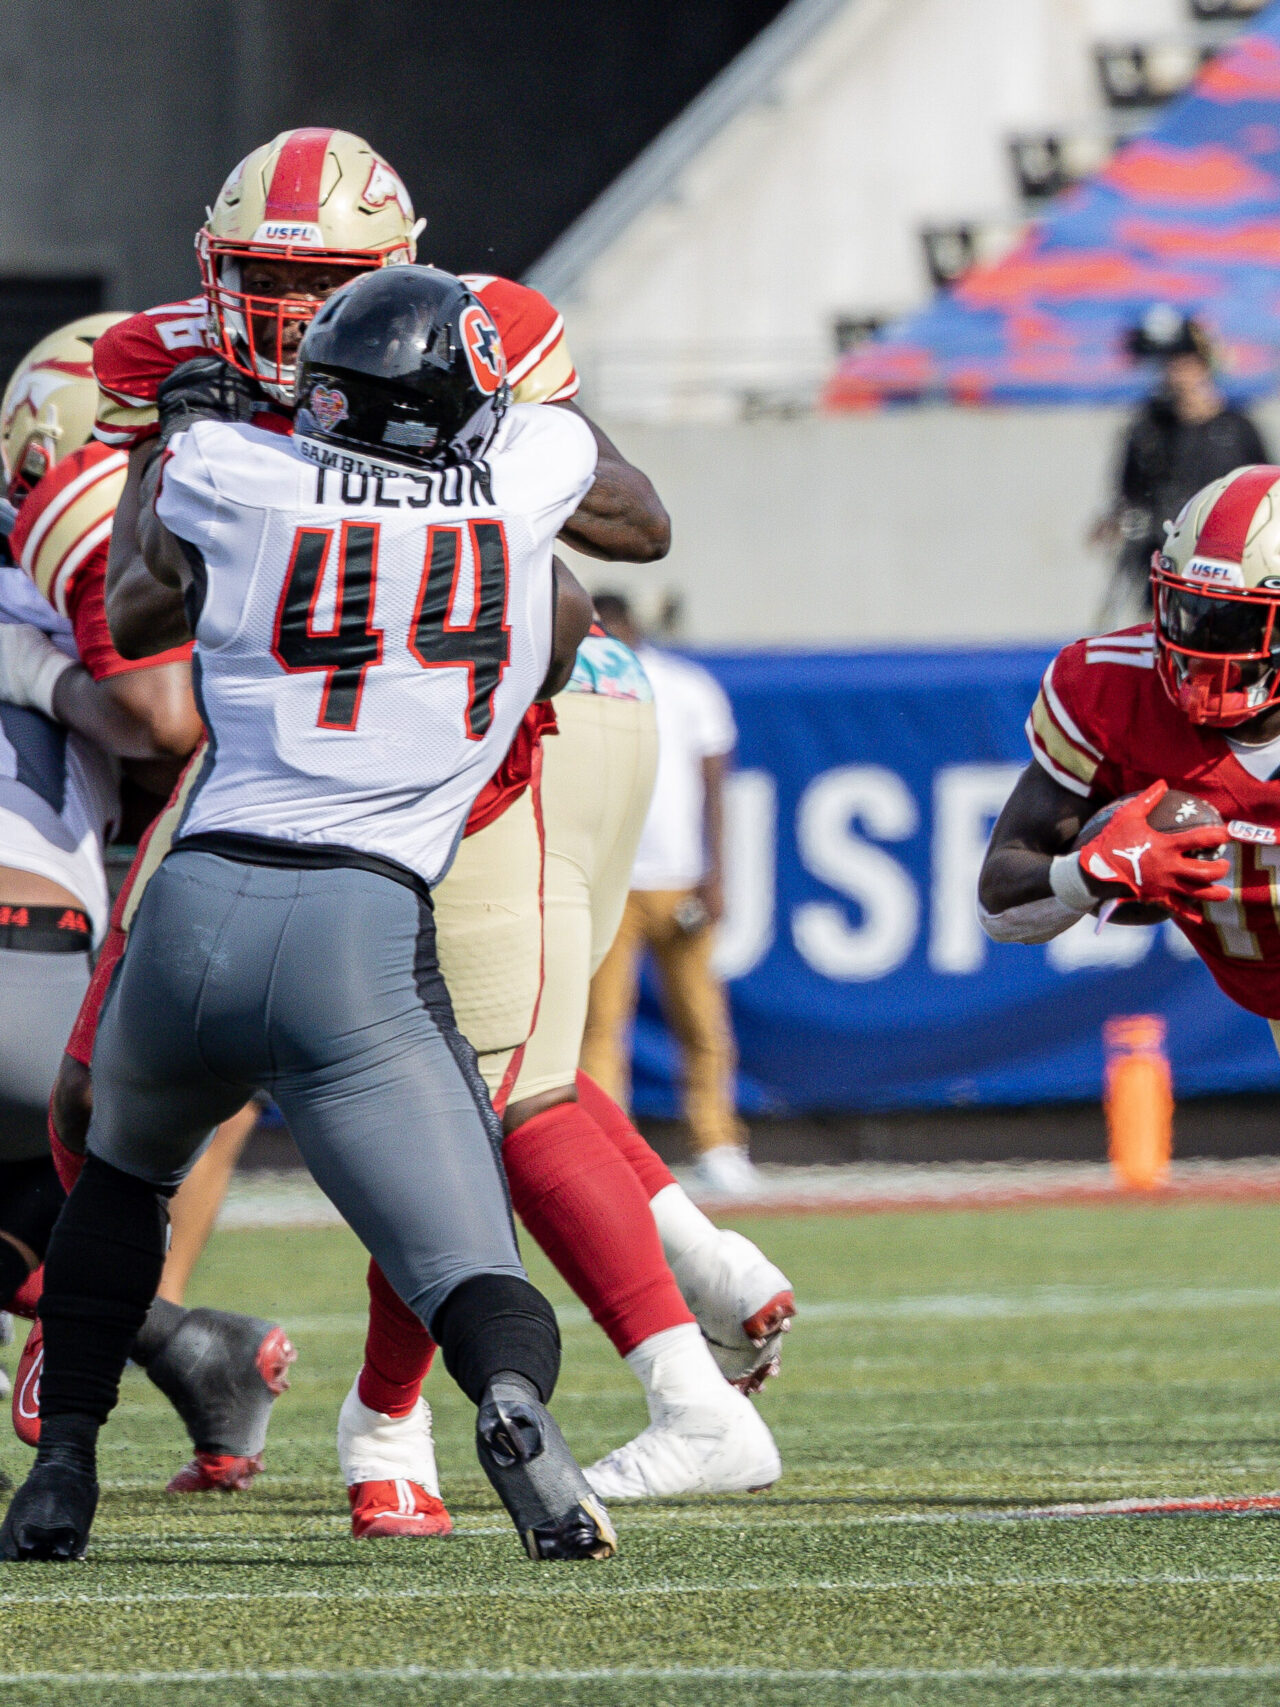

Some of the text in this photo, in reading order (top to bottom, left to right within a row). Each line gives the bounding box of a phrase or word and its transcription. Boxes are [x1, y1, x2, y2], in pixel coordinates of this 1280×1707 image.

[265, 226, 311, 241] USFL
[1191, 562, 1231, 581] USFL
[270, 518, 512, 741] 44
[1085, 632, 1155, 669] 11
[1230, 820, 1275, 843] USFL
